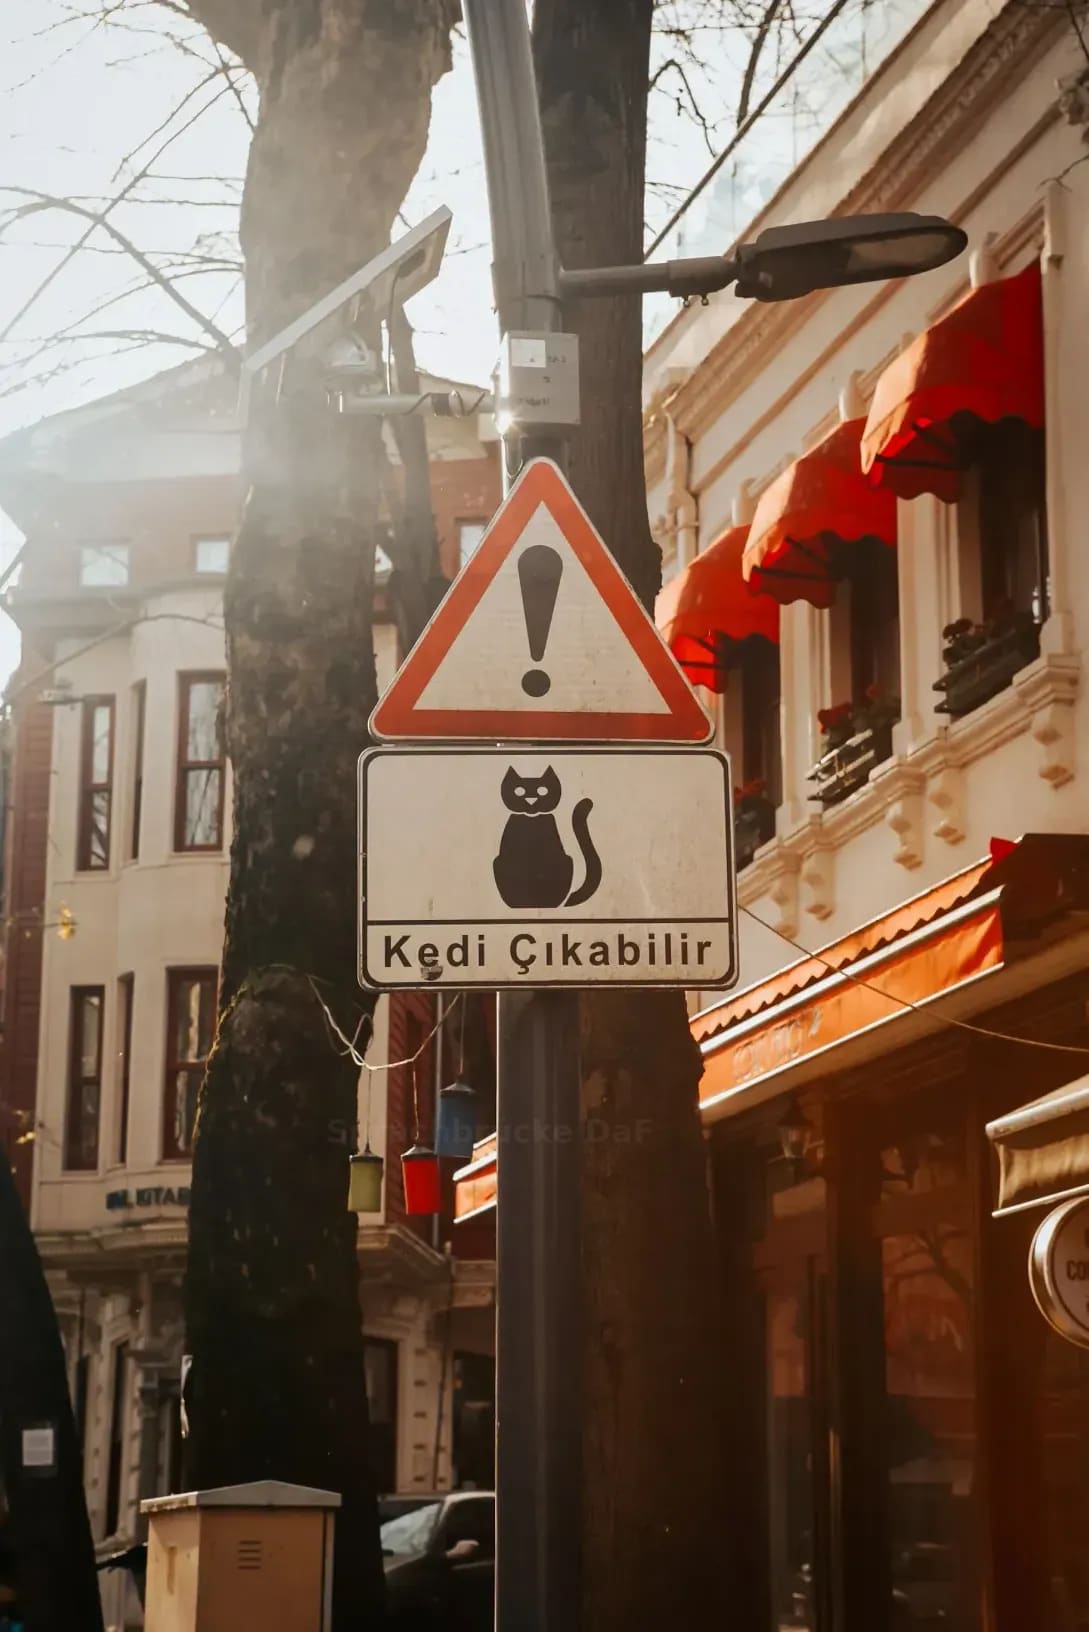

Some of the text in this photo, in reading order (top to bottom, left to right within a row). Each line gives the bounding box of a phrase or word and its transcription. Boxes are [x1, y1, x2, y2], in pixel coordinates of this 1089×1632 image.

[383, 933, 712, 975] Kedi Çıkabilir
[1066, 1259, 1089, 1280] CO
